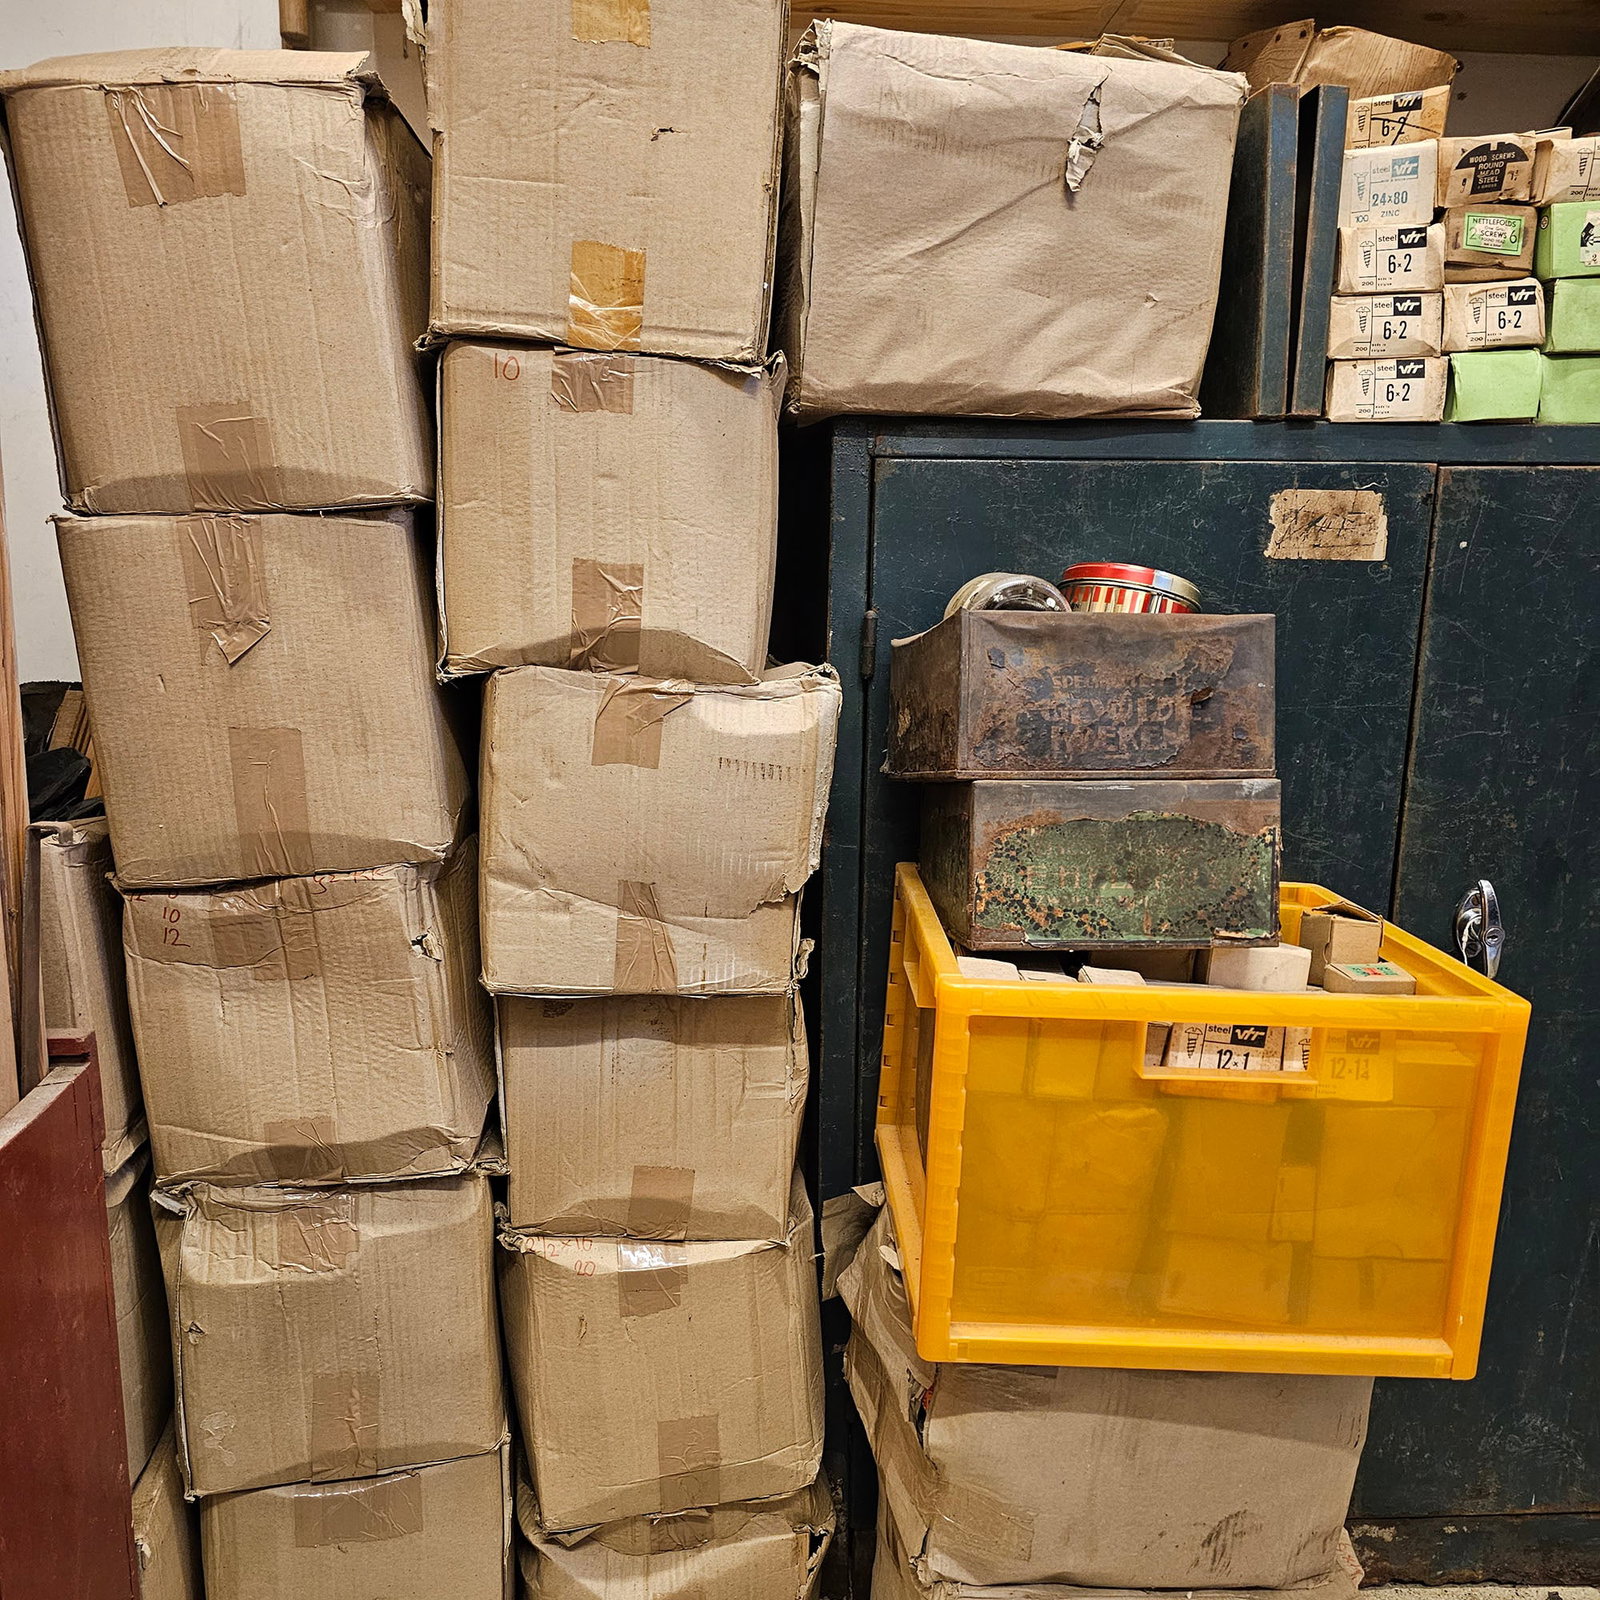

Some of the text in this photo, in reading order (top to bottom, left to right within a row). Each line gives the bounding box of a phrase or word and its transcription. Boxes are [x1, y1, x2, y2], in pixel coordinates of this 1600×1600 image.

[1373, 99, 1392, 107] steel
[1469, 152, 1516, 163] WOOD SCREWS
[1372, 165, 1390, 174] steel
[1478, 161, 1505, 170] ROUND
[1380, 209, 1400, 218] ZINC
[1472, 218, 1516, 227] NETTLEFOLDS
[1378, 234, 1397, 242] steel
[1480, 230, 1507, 239] SCREWS
[1509, 229, 1517, 244] 6
[1374, 301, 1392, 309] steel
[494, 352, 520, 381] 10
[162, 906, 181, 924] 10
[163, 927, 192, 948] 12
[1207, 1025, 1231, 1036] steel
[574, 1260, 596, 1277] 20
